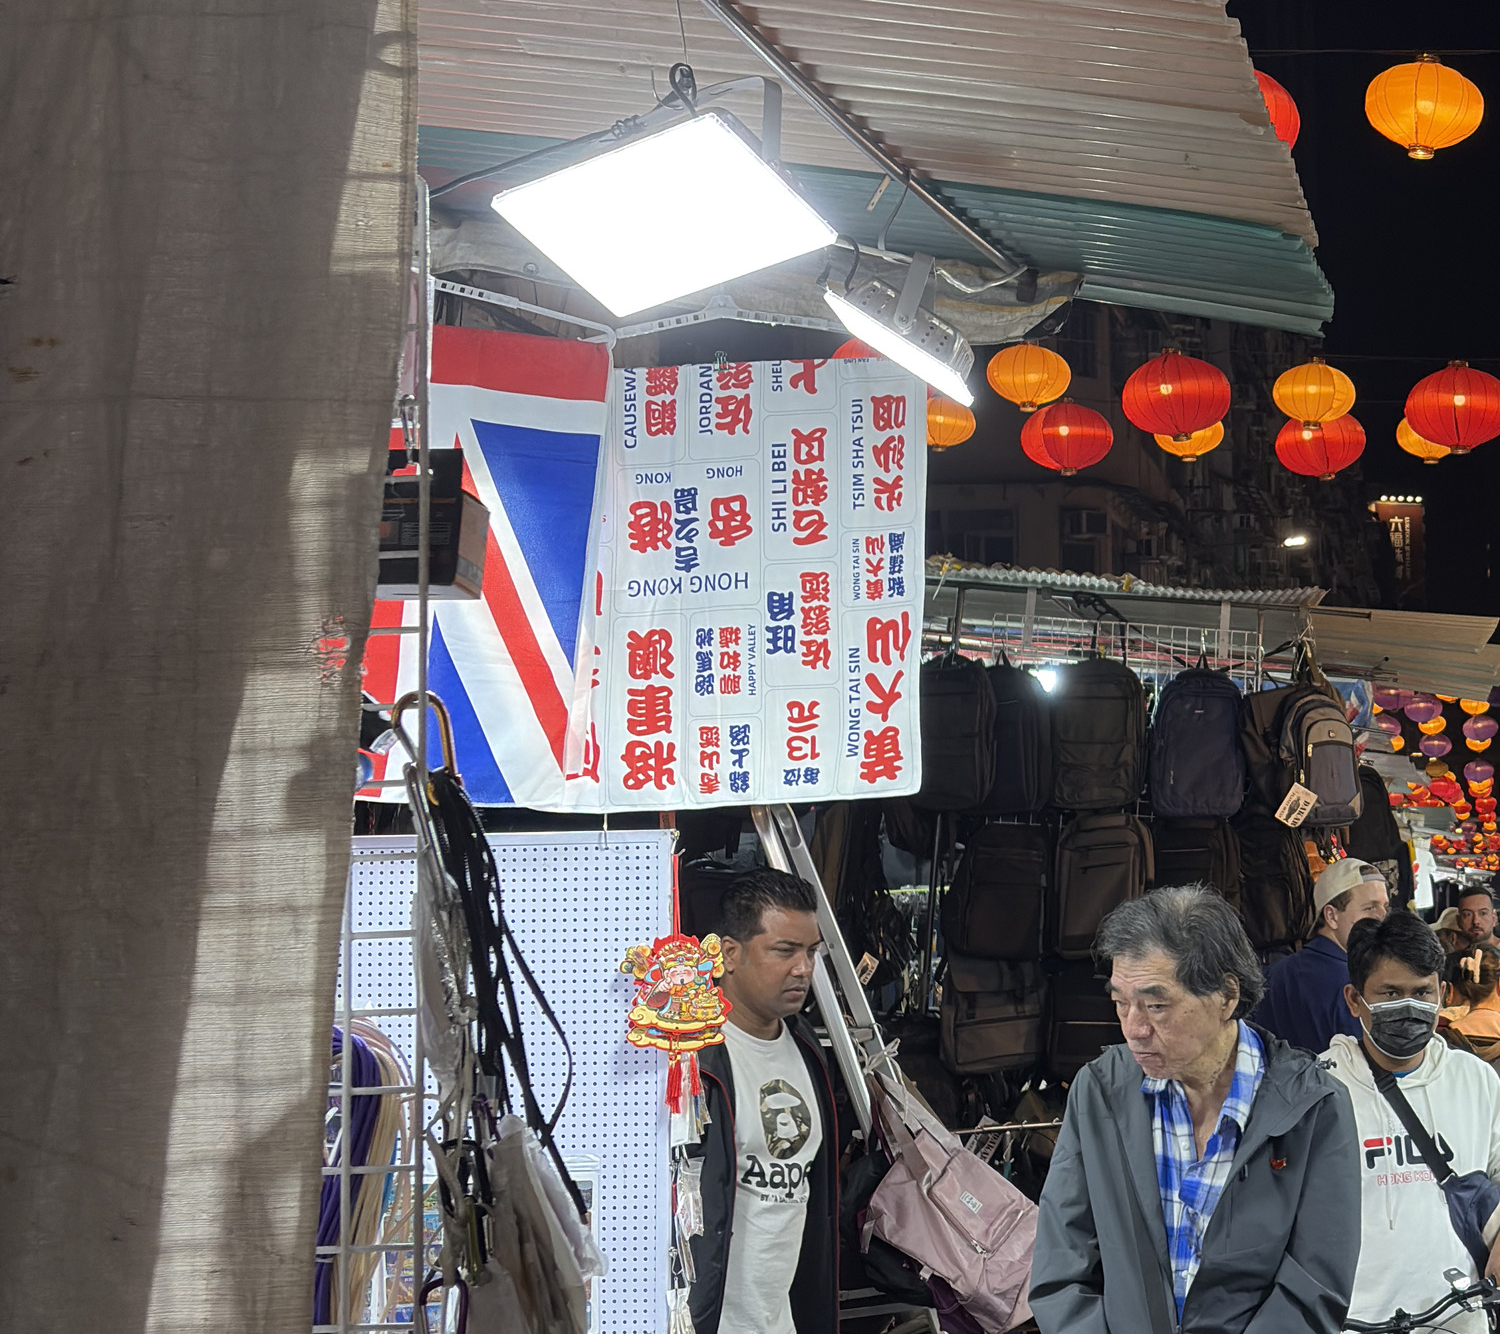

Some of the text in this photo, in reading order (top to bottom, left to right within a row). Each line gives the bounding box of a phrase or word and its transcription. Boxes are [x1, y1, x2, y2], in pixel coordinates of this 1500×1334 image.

[699, 365, 713, 435] JORDAN
[636, 472, 671, 484] KONG
[706, 466, 742, 479] HONG
[791, 428, 828, 545] 石梨貝
[852, 399, 864, 509] TSIM SHA TSUI
[871, 395, 905, 511] 尖沙咀
[772, 444, 786, 532] SHI LI BEI
[674, 487, 700, 573] 吉之島
[628, 572, 748, 597] HONG KONG
[765, 592, 796, 654] 旺角
[800, 572, 831, 669] 佐敦道
[695, 628, 714, 696] 跑馬地
[748, 663, 756, 695] HAPPY
[621, 629, 676, 790] 將軍澳
[787, 701, 819, 733] 元
[847, 648, 860, 757] WONG TAI SIN
[699, 726, 720, 794] 青山道
[729, 724, 750, 793] 錦上路
[784, 767, 819, 786] 每位
[787, 736, 820, 761] 13
